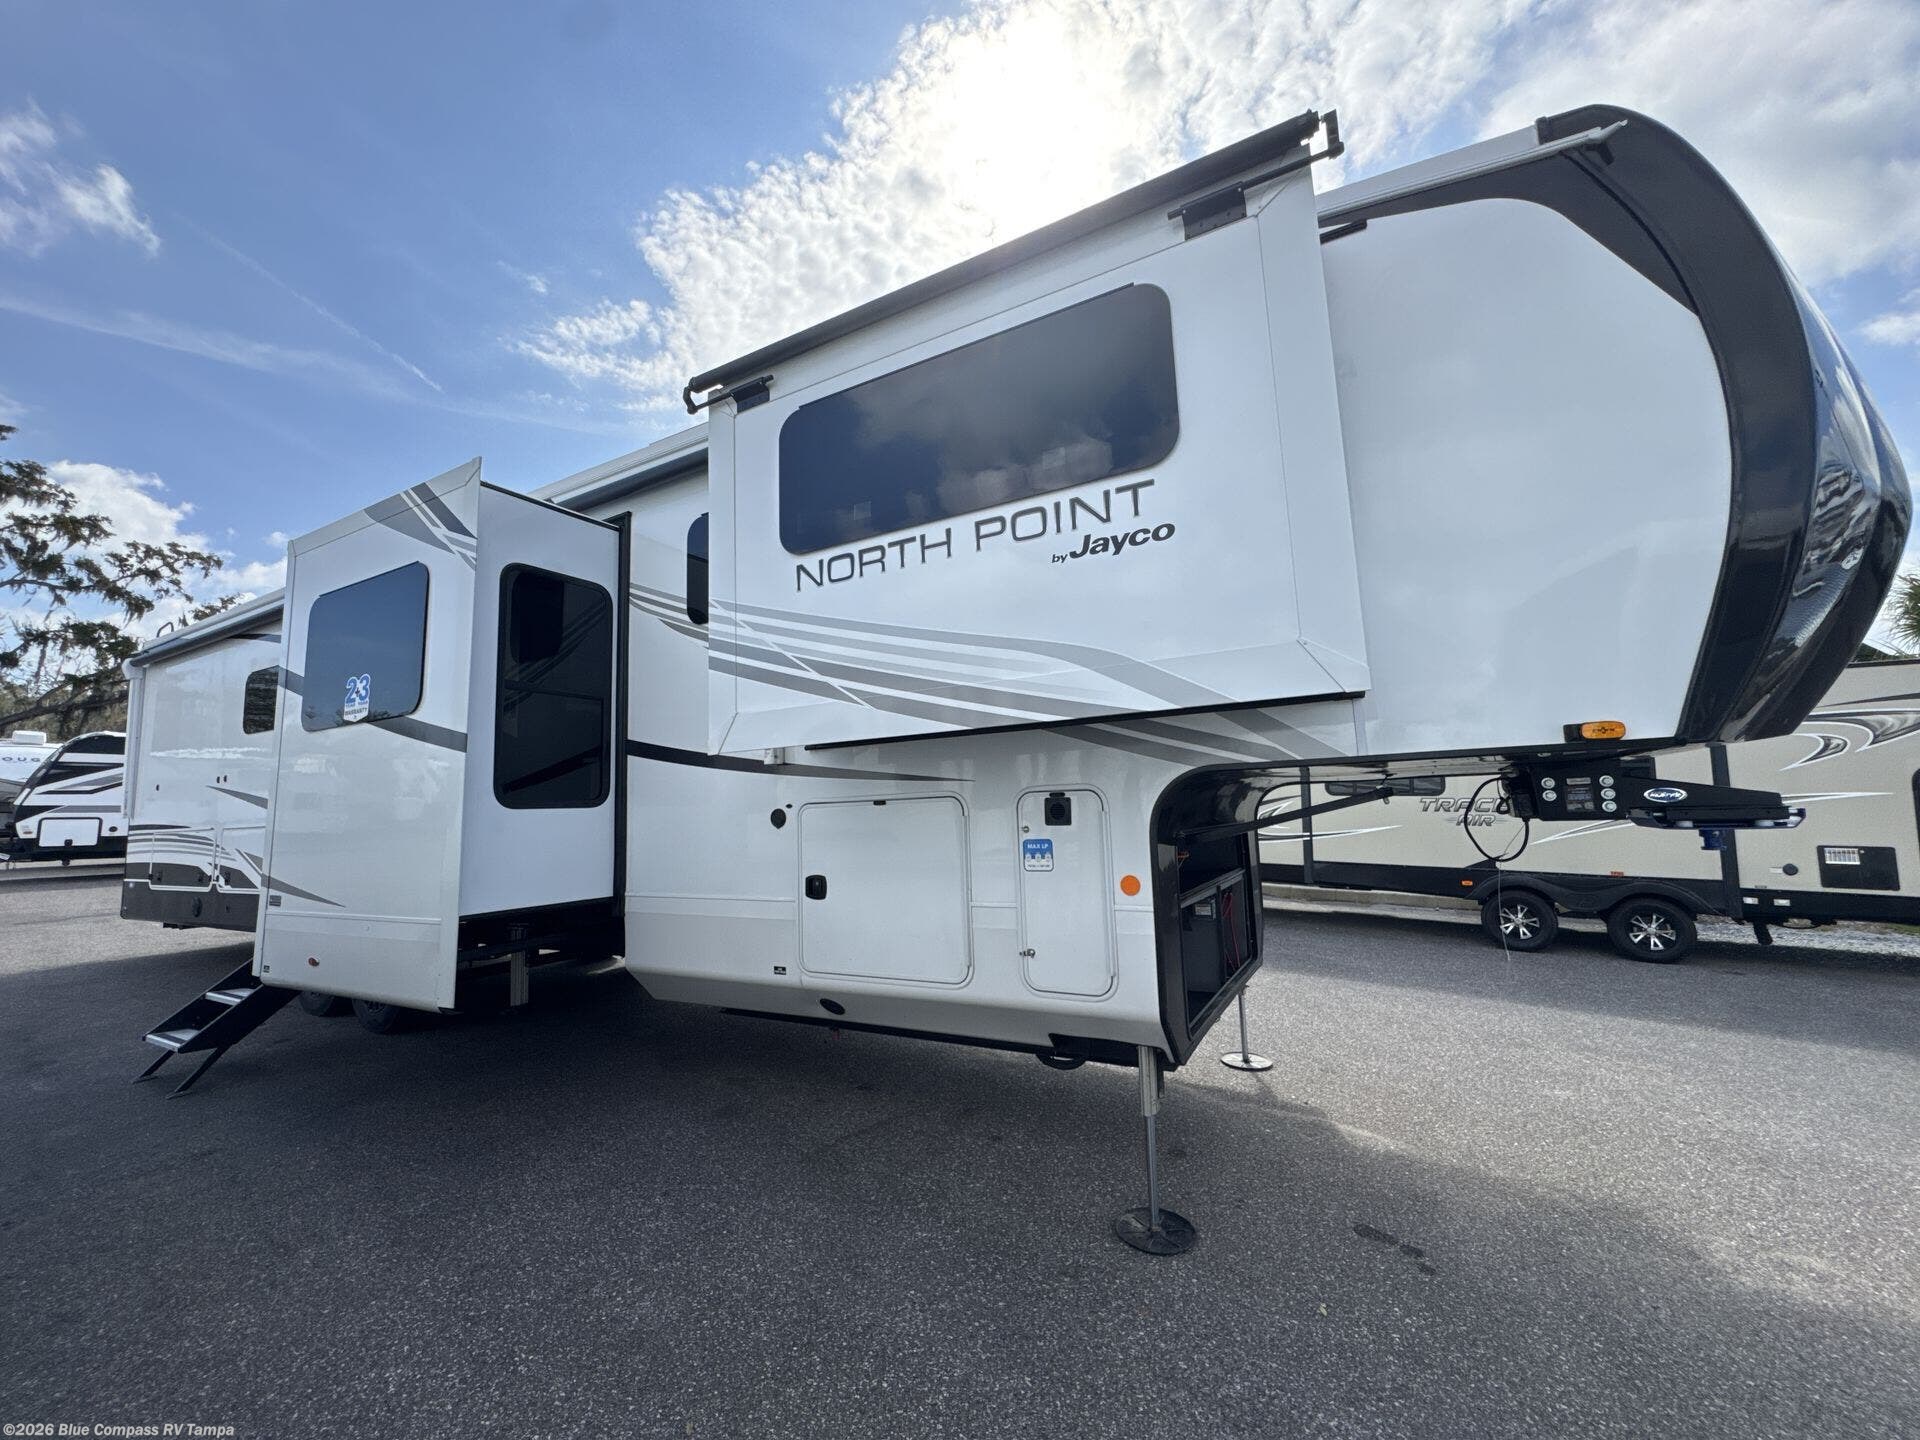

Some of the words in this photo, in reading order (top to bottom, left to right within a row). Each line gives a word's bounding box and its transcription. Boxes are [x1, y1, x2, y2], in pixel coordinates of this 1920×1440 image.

[796, 527, 952, 592] NORTH
[974, 479, 1155, 551] POINT
[1051, 552, 1068, 564] by
[1068, 523, 1176, 560] Jayco
